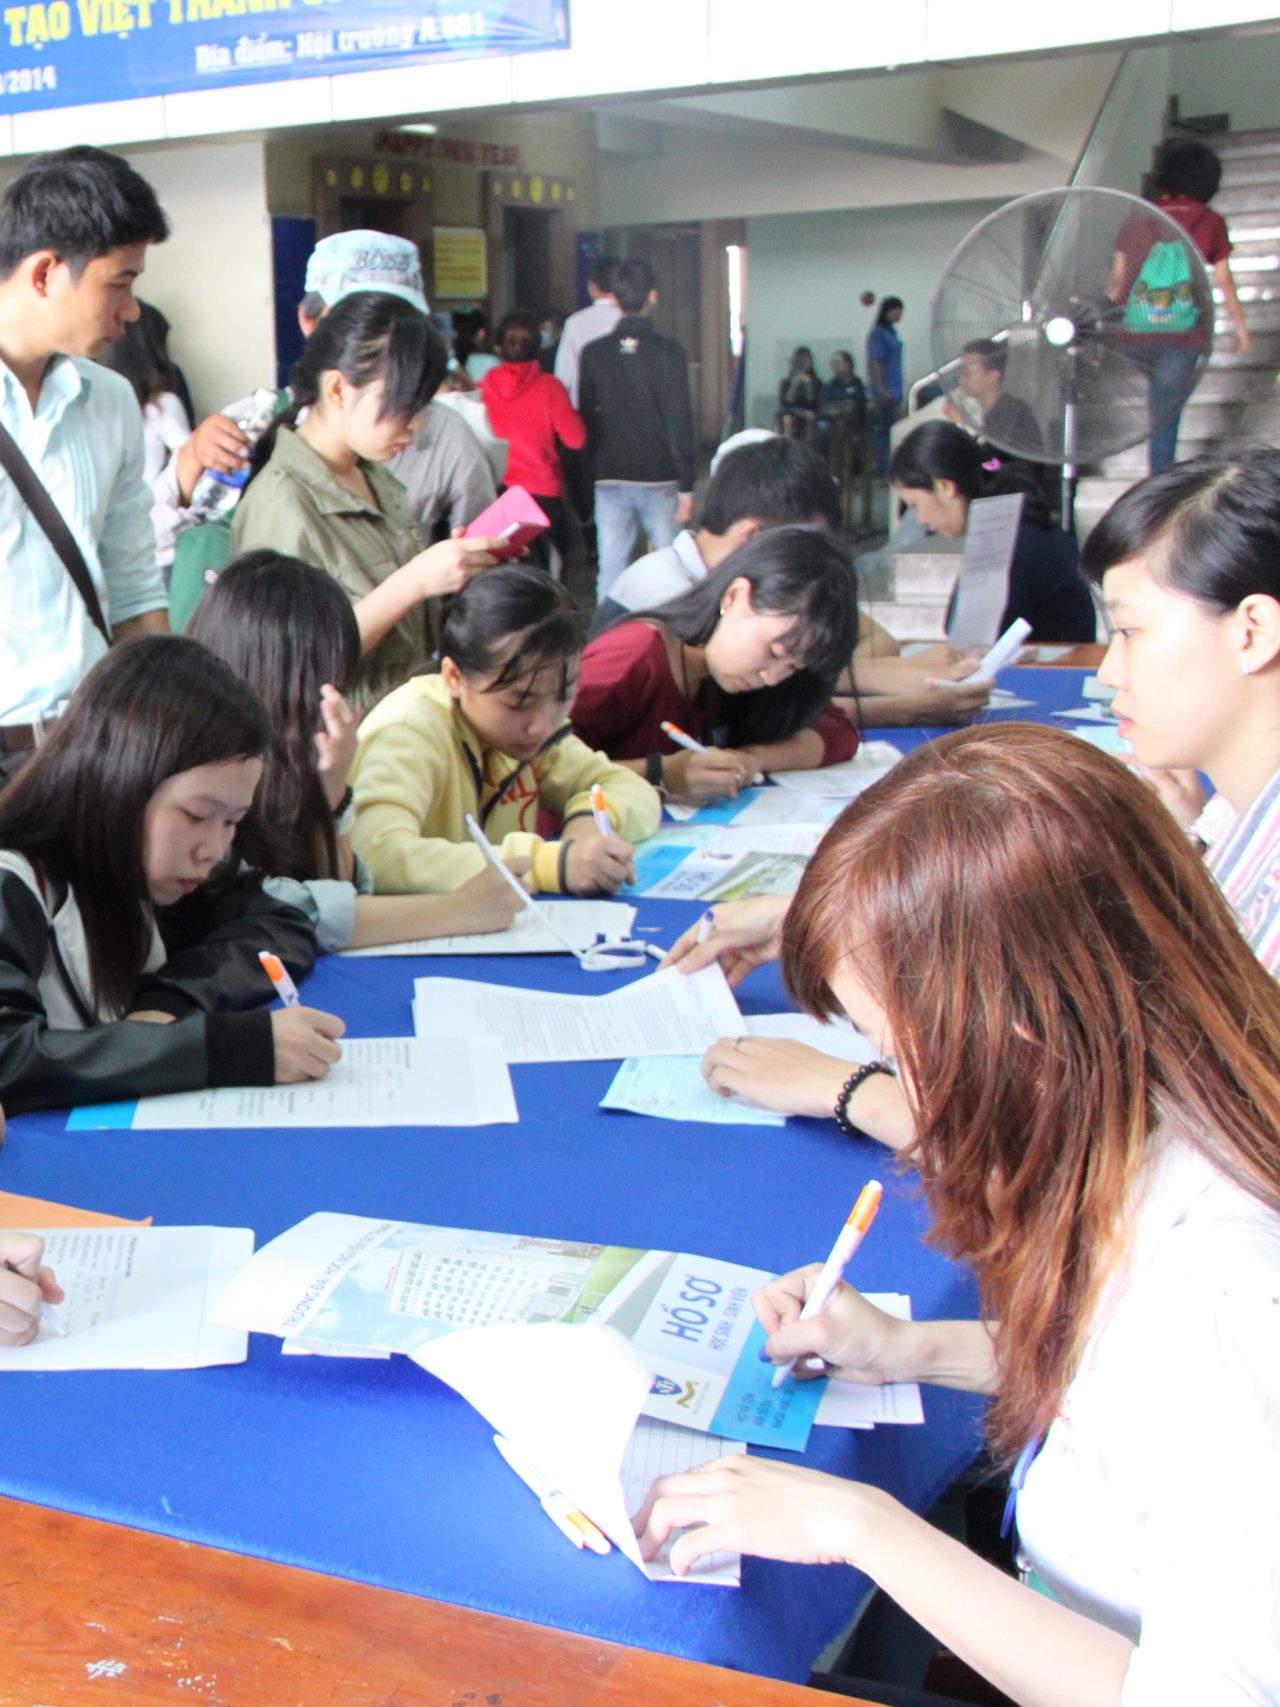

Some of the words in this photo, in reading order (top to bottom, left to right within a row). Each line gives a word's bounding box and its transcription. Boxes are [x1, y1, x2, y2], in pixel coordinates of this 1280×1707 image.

[4, 0, 71, 50] TẠO
[679, 1273, 723, 1309] SƠ
[659, 1303, 710, 1343] HỒ
